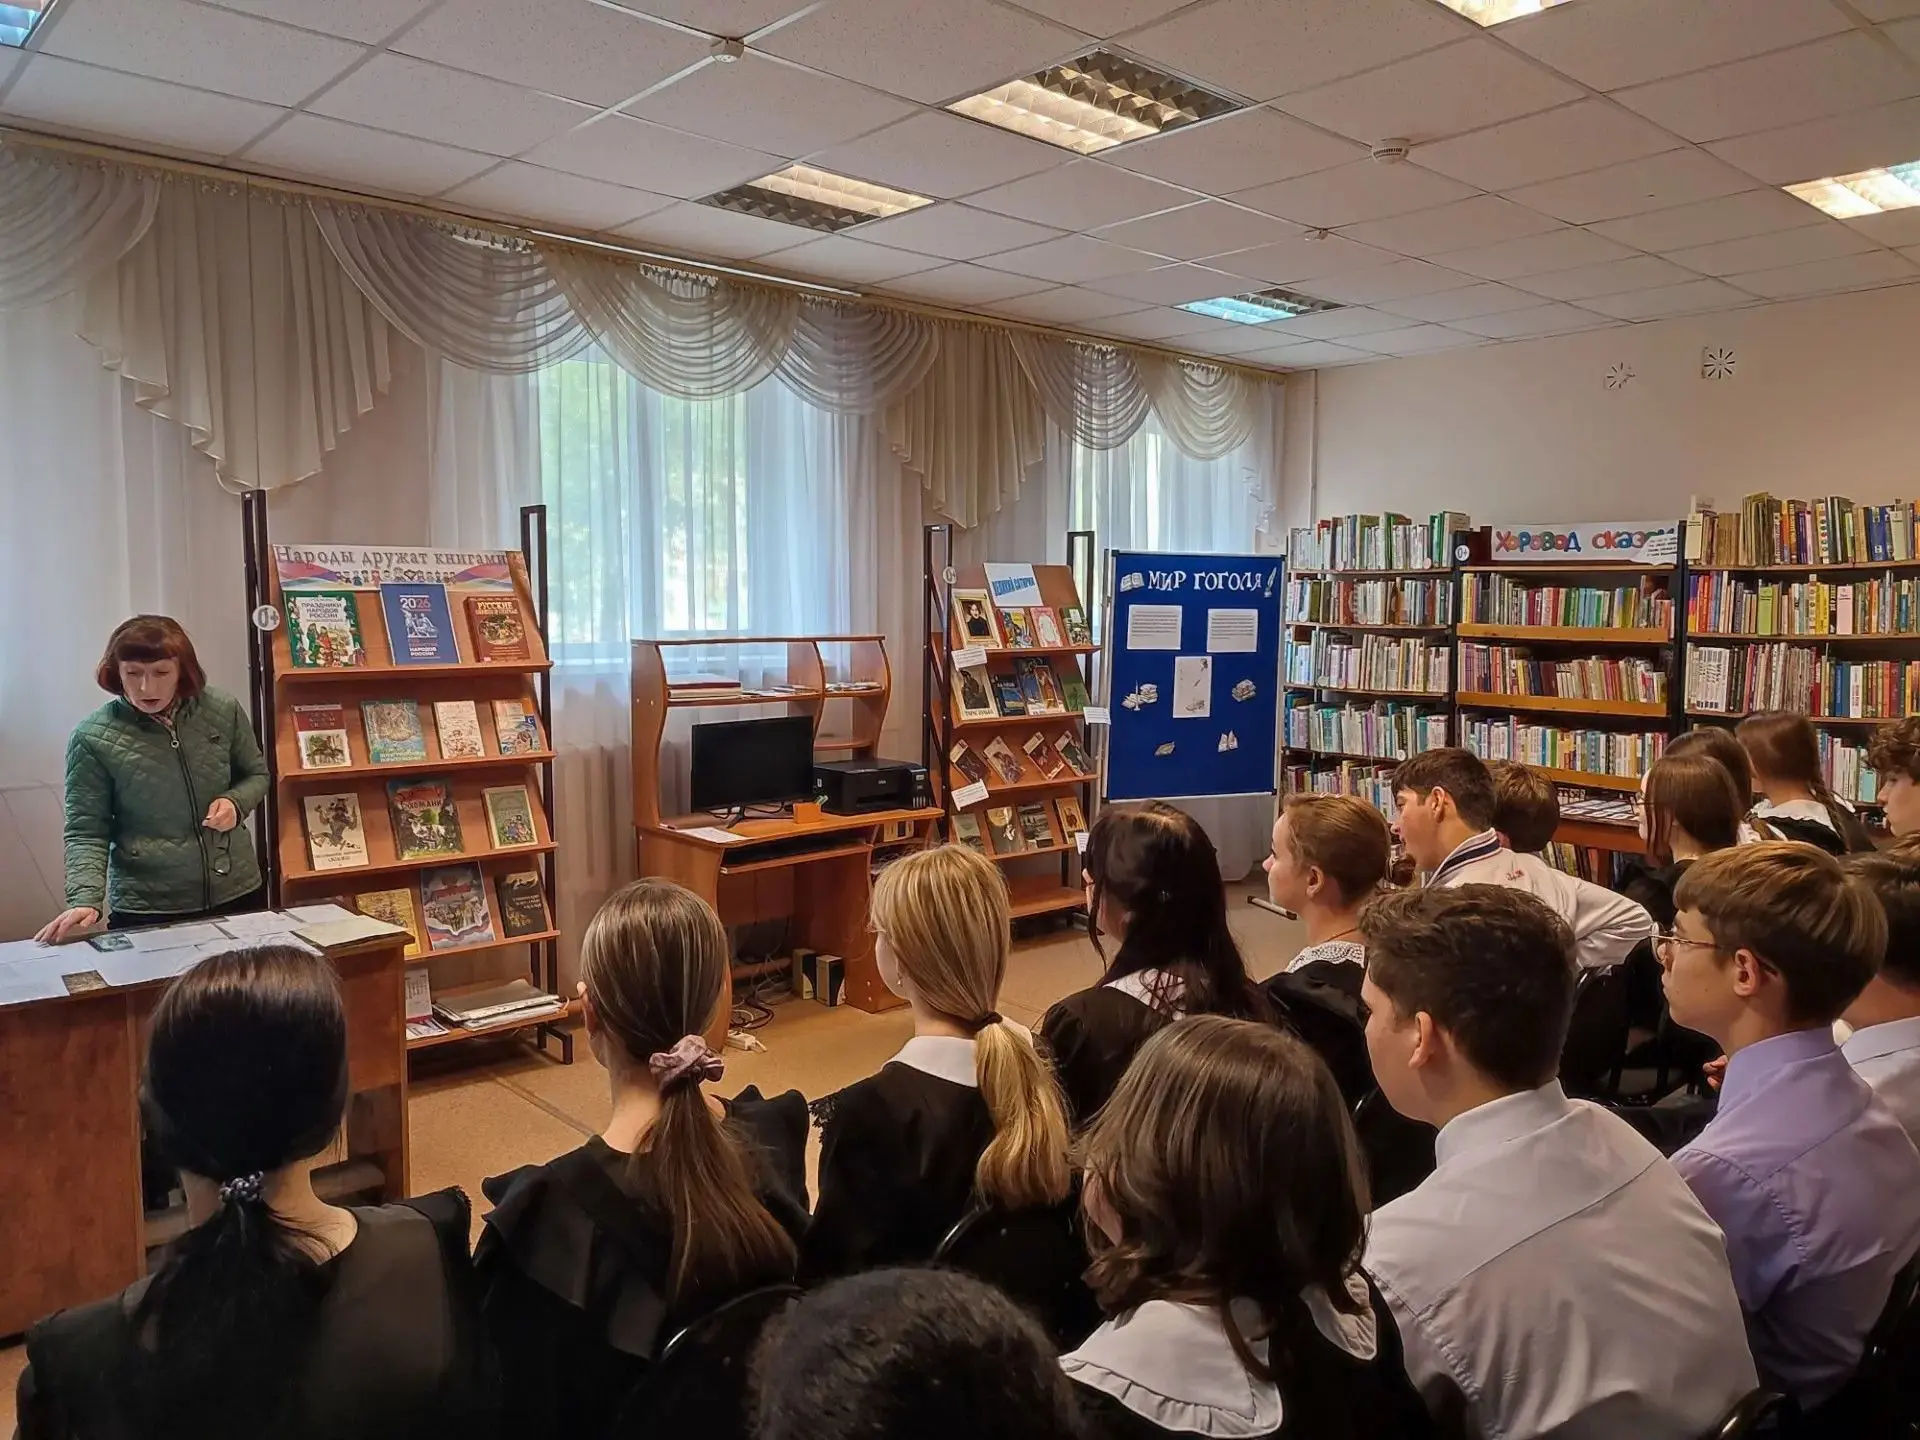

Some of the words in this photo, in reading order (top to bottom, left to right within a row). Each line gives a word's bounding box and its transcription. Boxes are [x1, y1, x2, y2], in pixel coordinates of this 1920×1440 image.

[274, 546, 355, 568] Народы
[361, 550, 427, 569] дружат
[433, 552, 508, 566] книгами
[1457, 547, 1468, 559] 0+
[1148, 570, 1187, 591] МИР
